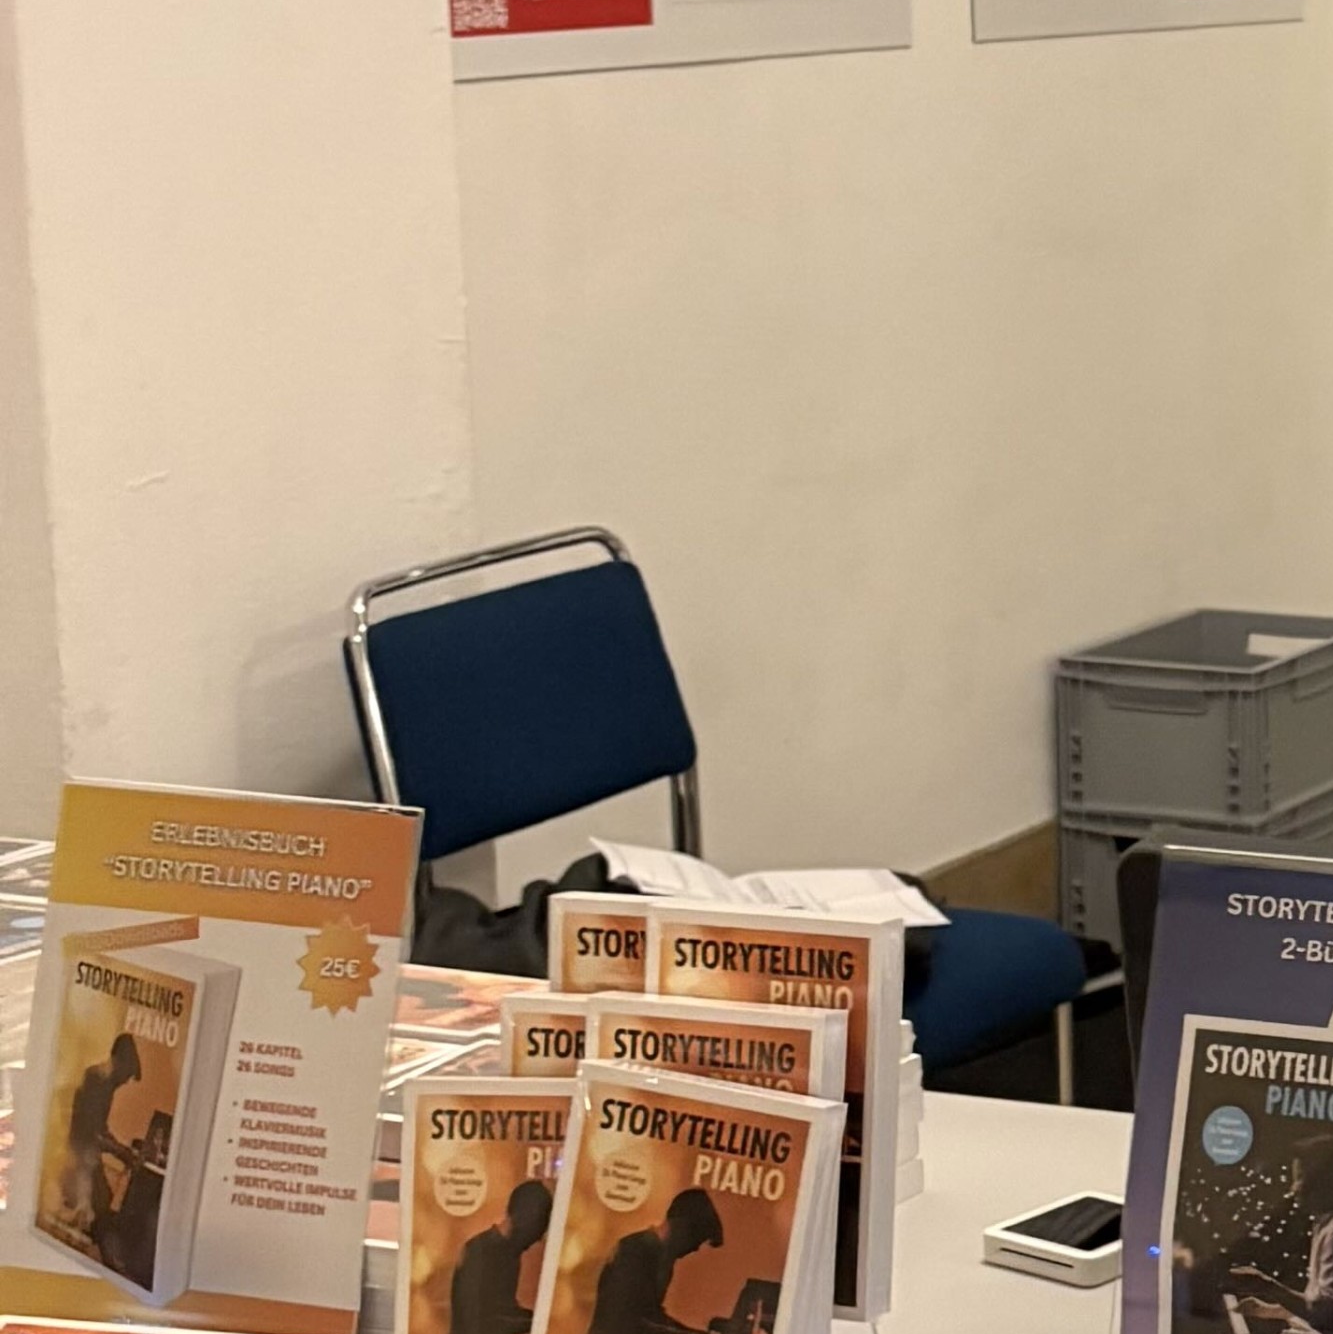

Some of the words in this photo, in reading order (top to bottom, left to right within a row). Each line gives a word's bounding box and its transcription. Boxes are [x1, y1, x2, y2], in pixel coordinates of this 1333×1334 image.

[150, 820, 325, 858] ERLEBNISBUCH
[320, 955, 361, 979] 25€
[674, 938, 855, 981] STORYTELLING
[75, 961, 184, 1017] STORYTELLING
[769, 980, 853, 1009] PIANO
[125, 1006, 179, 1047] PIANO
[614, 1028, 795, 1073] STORYTELLING
[599, 1098, 791, 1164] STORYTELLING
[693, 1154, 785, 1201] PIANO
